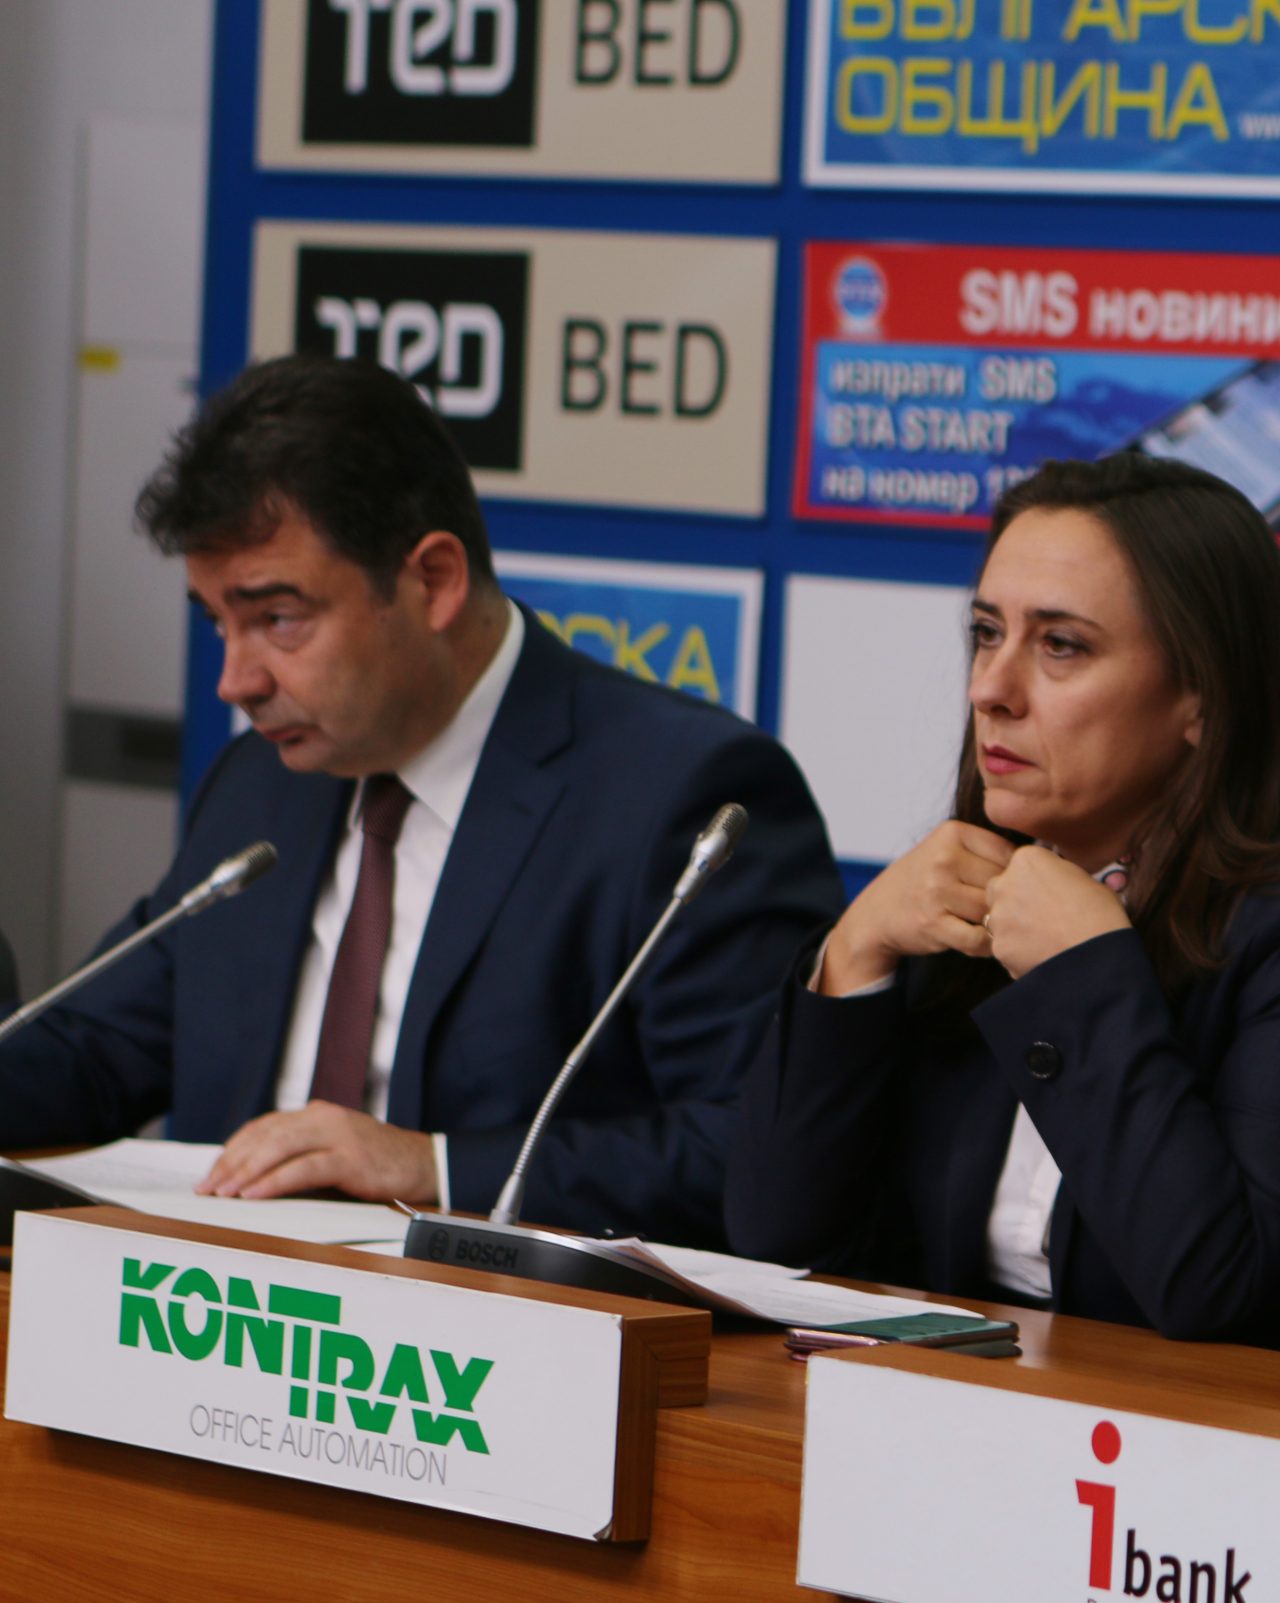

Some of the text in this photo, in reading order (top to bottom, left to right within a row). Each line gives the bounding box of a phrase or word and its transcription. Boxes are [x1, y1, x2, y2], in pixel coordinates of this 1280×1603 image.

[574, 0, 742, 87] BED
[836, 56, 1230, 154] ОБЩИНА
[959, 269, 1080, 337] SMS
[560, 318, 729, 420] BED
[979, 355, 1057, 402] SMS
[826, 403, 1014, 455] BTA START
[455, 1237, 519, 1269] BOSCH
[118, 1256, 495, 1455] KONTRAX
[189, 1404, 448, 1486] OFFICE AUTOMATION
